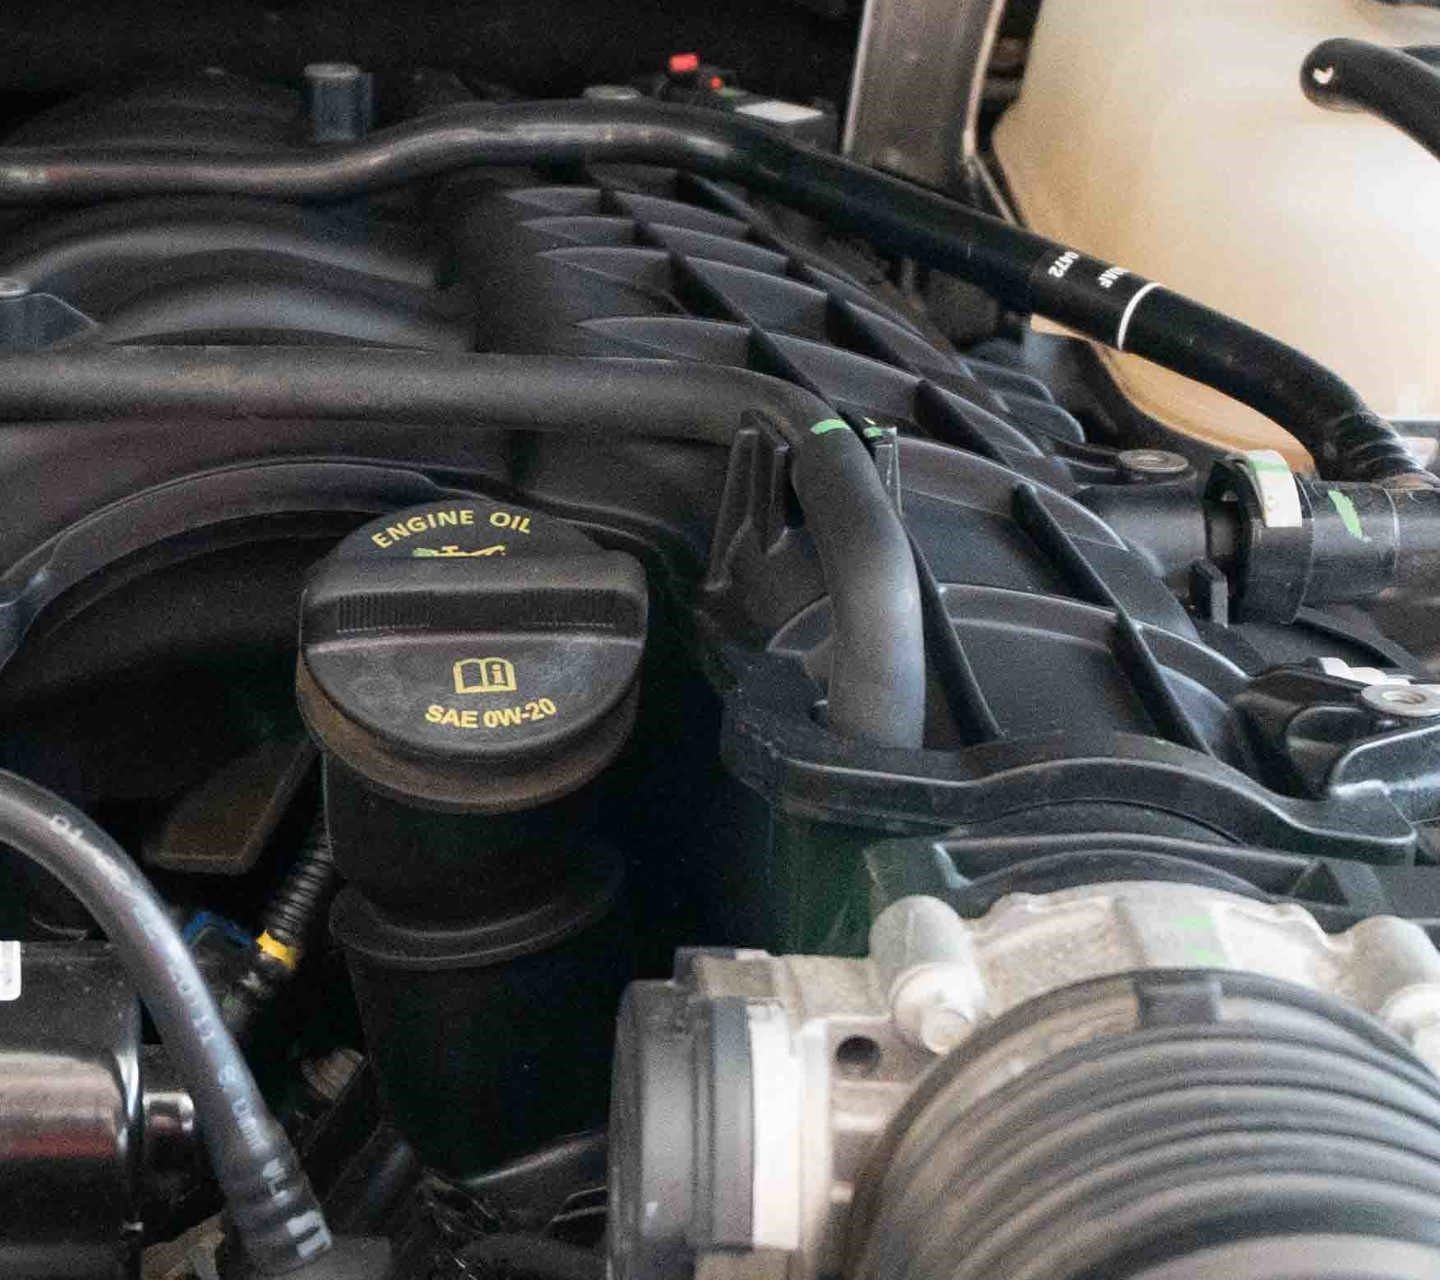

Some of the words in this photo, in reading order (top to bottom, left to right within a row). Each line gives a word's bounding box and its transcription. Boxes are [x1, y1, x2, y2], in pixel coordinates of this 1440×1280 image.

[371, 509, 475, 549] ENGINE
[489, 511, 532, 535] OIL
[424, 703, 480, 729] SAE
[483, 697, 558, 729] 0W-20
